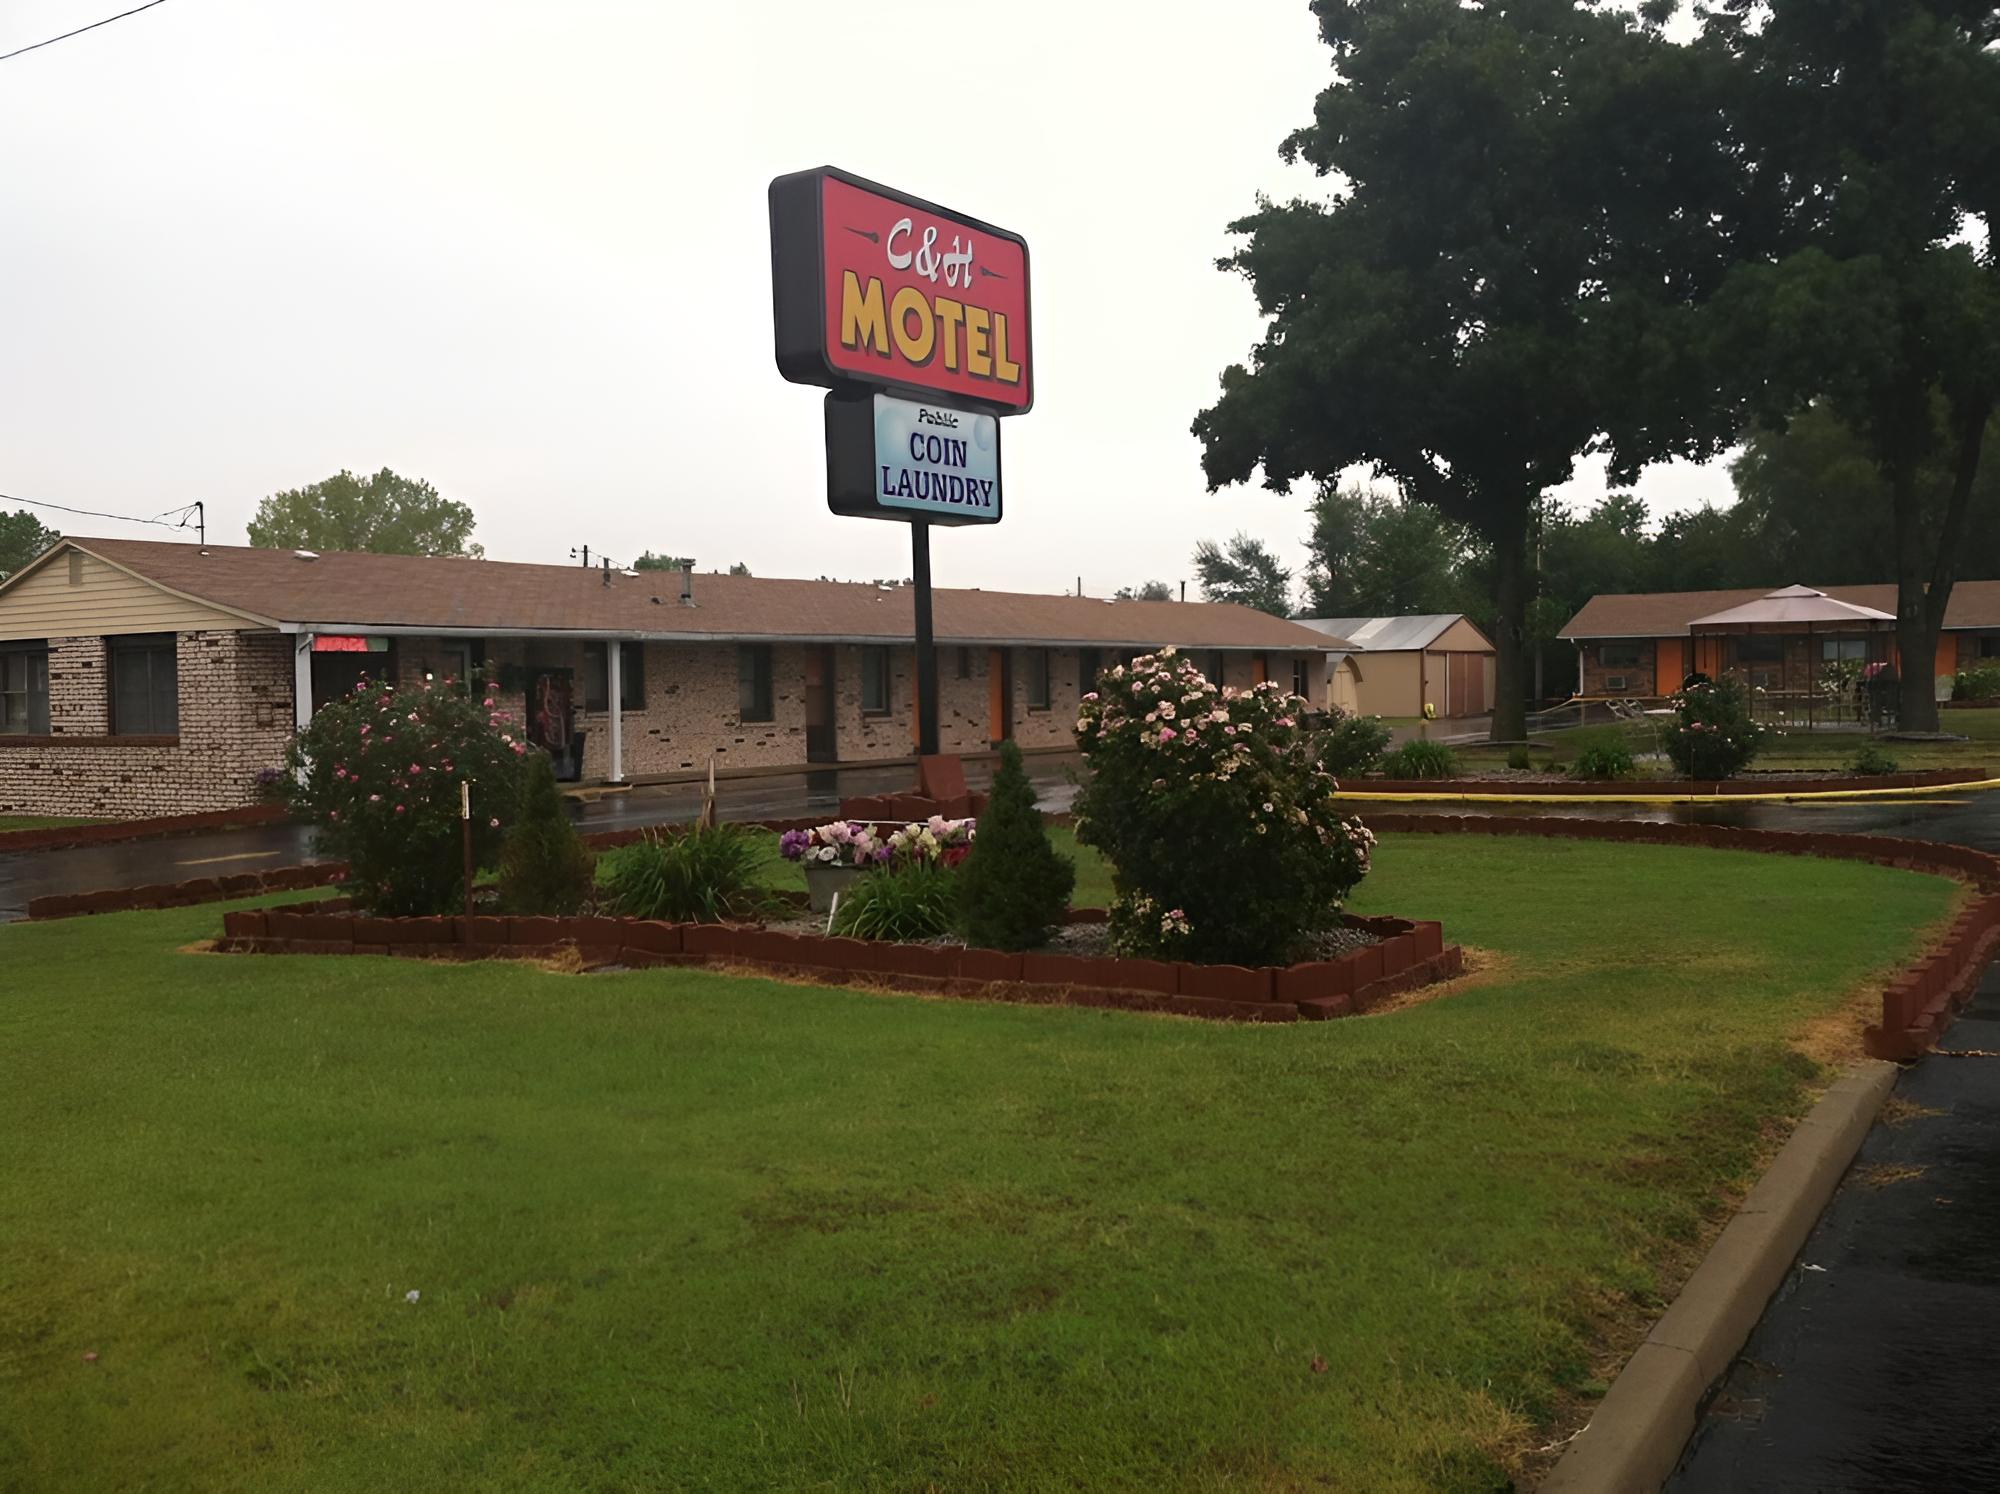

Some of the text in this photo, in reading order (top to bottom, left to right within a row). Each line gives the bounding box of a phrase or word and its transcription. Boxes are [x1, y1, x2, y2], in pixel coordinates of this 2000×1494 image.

[887, 218, 974, 288] C&H
[841, 269, 1021, 384] MOTEL
[910, 432, 967, 468] COIN
[881, 465, 993, 507] LAUNDRY
